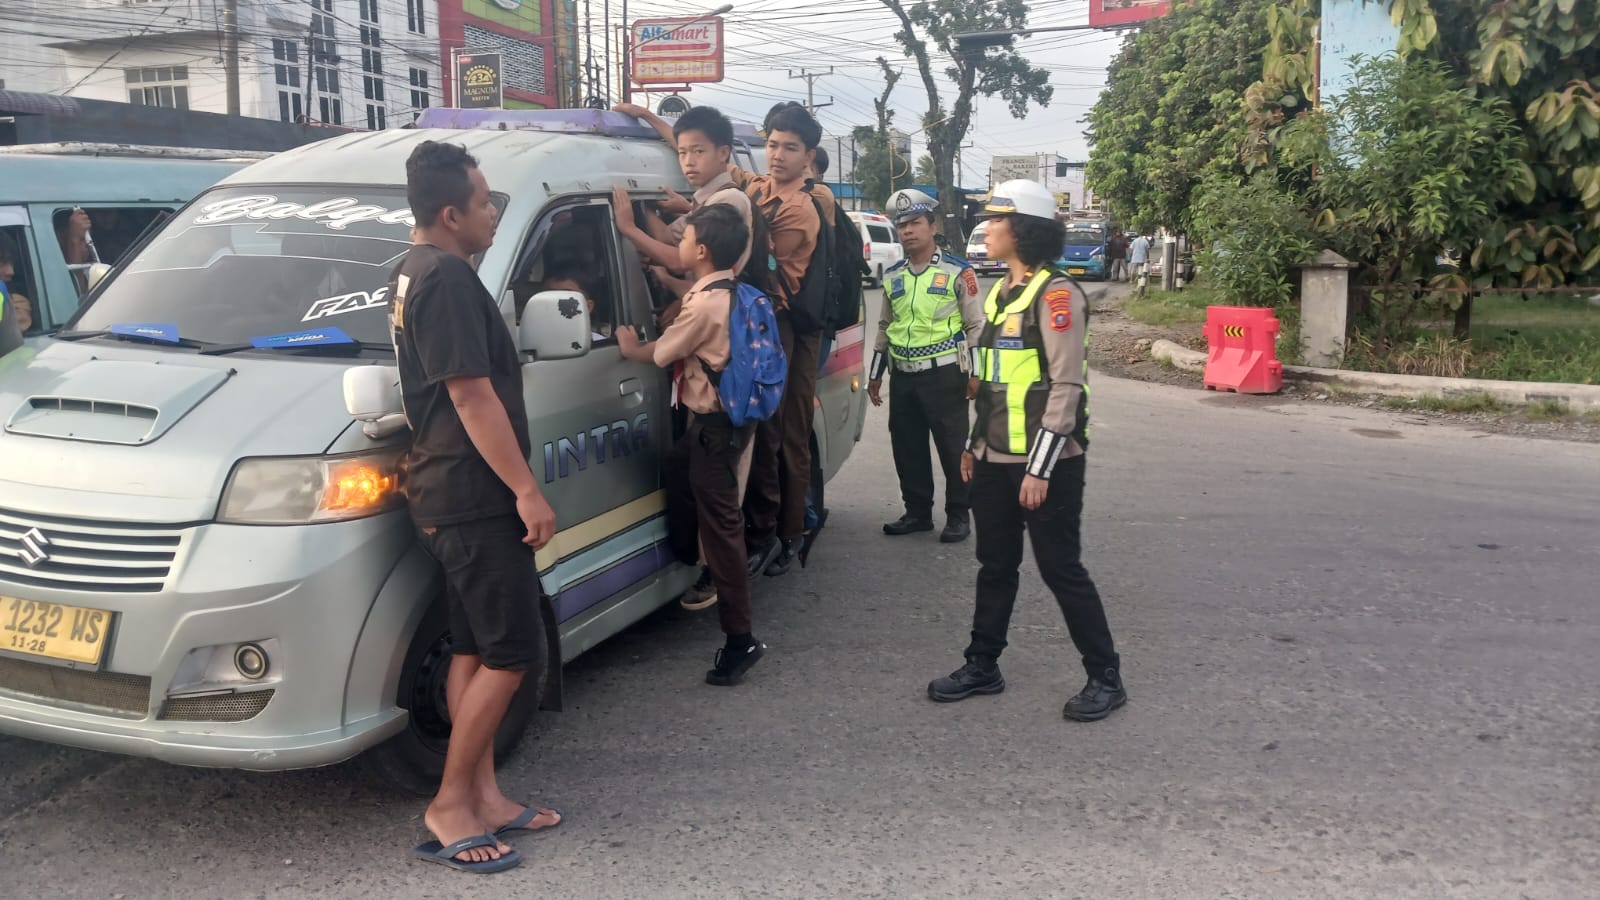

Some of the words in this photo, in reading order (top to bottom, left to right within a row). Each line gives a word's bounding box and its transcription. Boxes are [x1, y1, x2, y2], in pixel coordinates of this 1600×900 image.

[641, 26, 709, 41] Alfamart
[463, 86, 497, 96] MAGNUM
[543, 411, 648, 484] INTRA
[5, 599, 63, 638] 1232
[70, 608, 103, 643] WS
